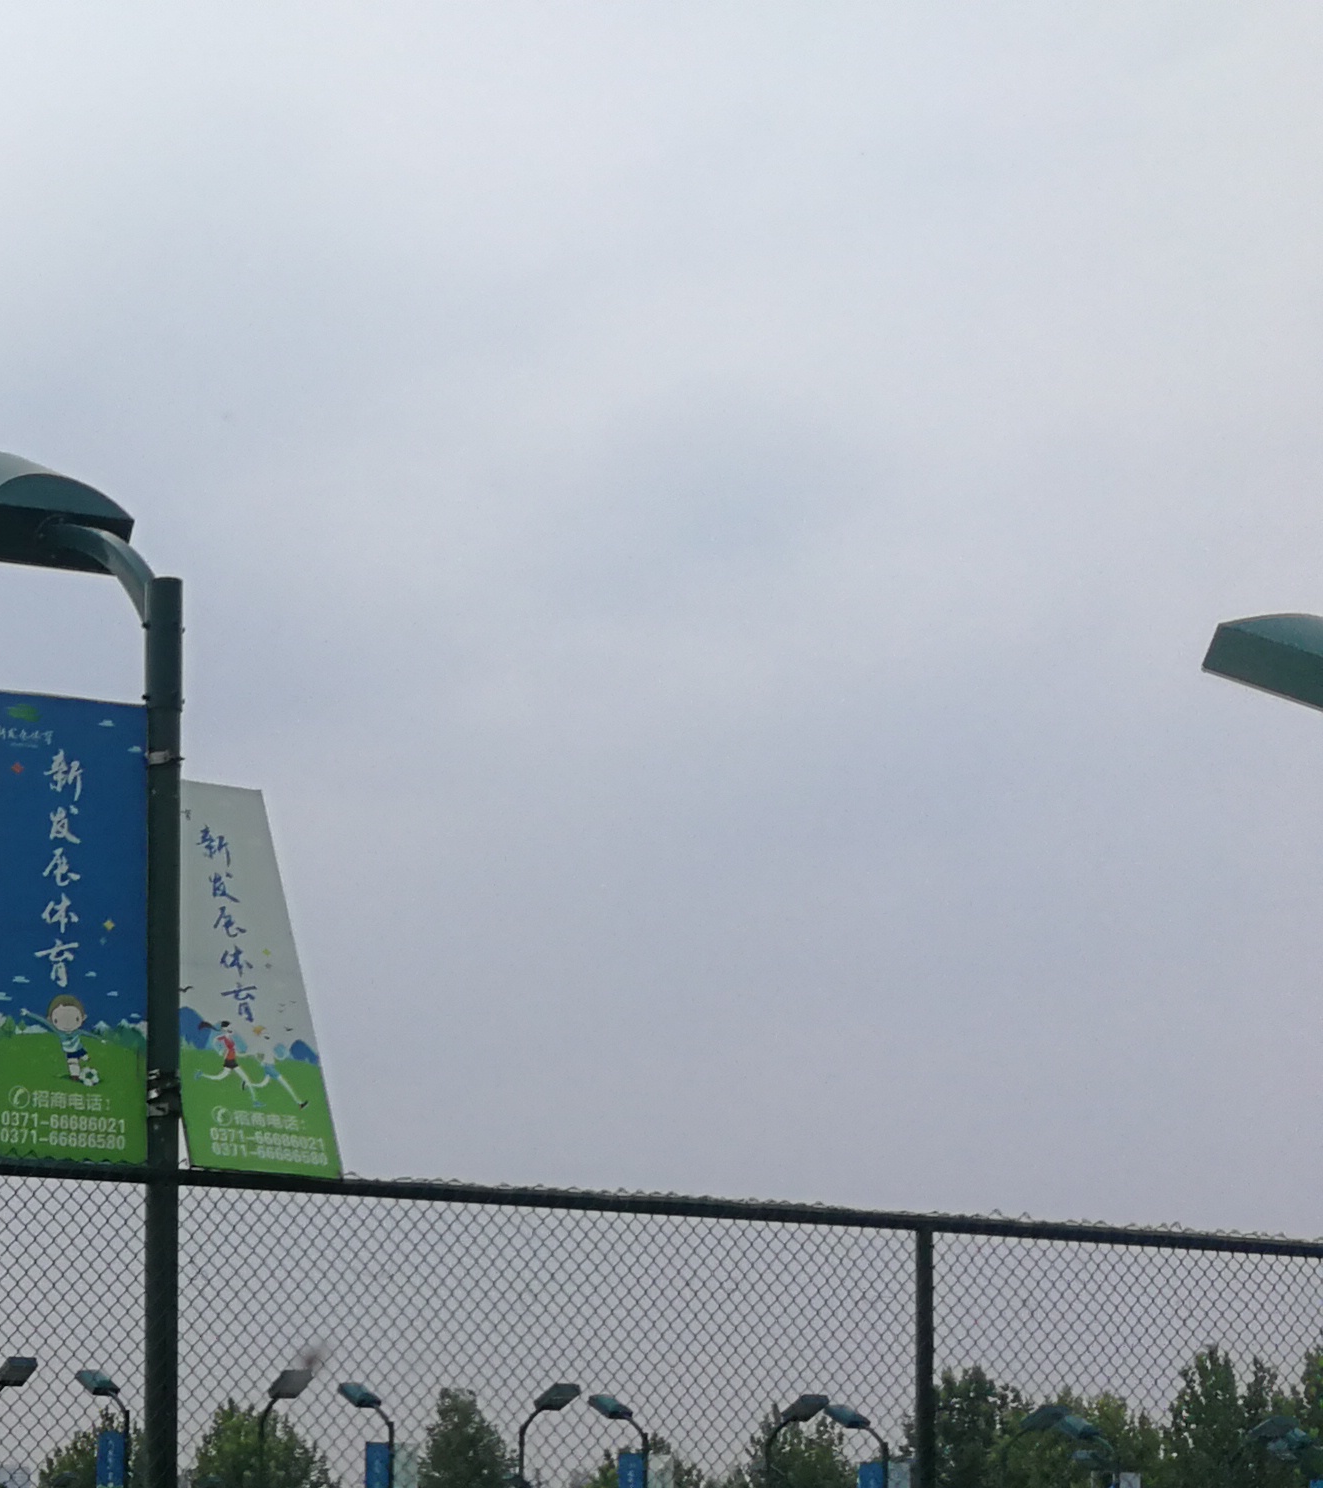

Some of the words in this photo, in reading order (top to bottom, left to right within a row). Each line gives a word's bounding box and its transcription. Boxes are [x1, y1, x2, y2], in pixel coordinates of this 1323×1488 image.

[35, 749, 83, 988] 新发展体育
[197, 824, 257, 1023] 新发展体育
[0, 1110, 125, 1133] 0371-66686021
[0, 1127, 126, 1150] 0371-66686580
